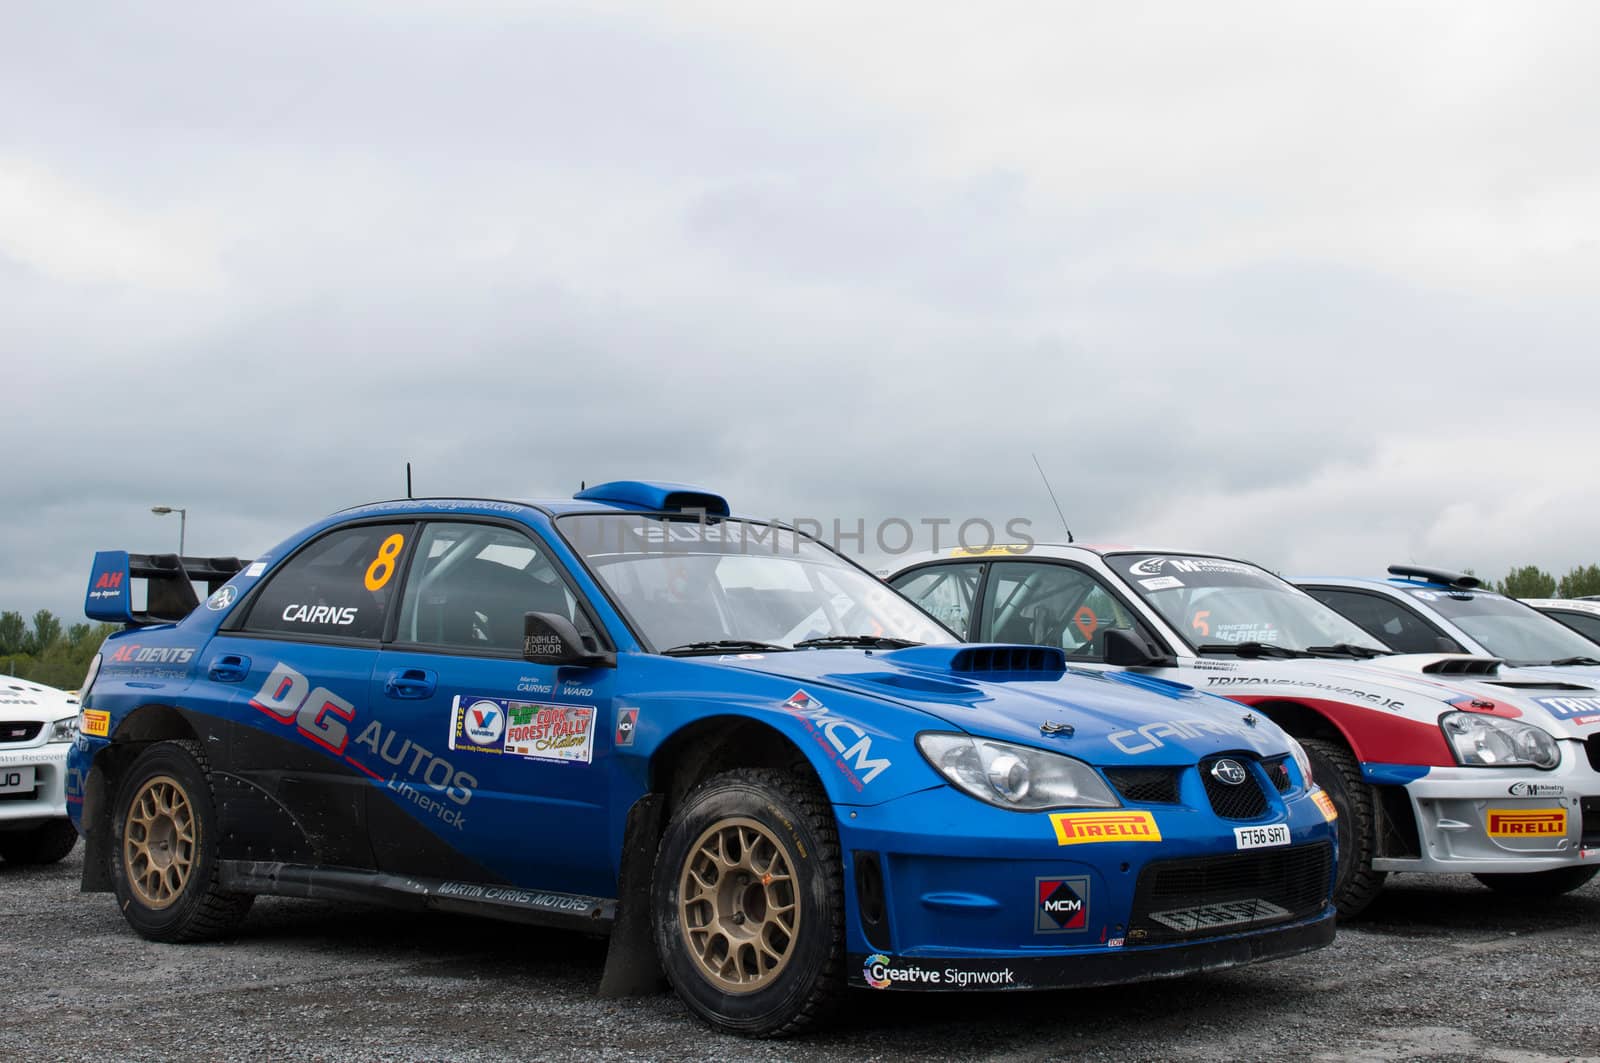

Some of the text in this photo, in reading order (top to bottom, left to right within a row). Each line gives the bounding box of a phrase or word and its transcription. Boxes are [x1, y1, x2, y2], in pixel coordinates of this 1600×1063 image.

[364, 533, 404, 592] 8
[95, 571, 124, 589] AH
[282, 603, 358, 625] CAIRNS
[135, 647, 196, 663] DENTS
[531, 644, 562, 654] DEKOR
[516, 683, 553, 694] CAIRNS
[563, 687, 594, 697] WARD
[248, 661, 357, 756] DG
[537, 709, 564, 725] CORK
[456, 707, 465, 737] 2012
[507, 719, 590, 743] FOREST RALLY
[815, 706, 892, 785] MCM
[354, 720, 478, 805] AUTOS
[386, 772, 467, 831] Limerick
[1060, 815, 1150, 838] PIRELLI
[1490, 814, 1564, 833] PIRELLI
[1240, 827, 1287, 844] FT56 SRT
[437, 882, 591, 911] MARTIN CAIRNS MOTORS
[1044, 900, 1081, 911] MCM
[872, 964, 1015, 987] Creative Signwork
